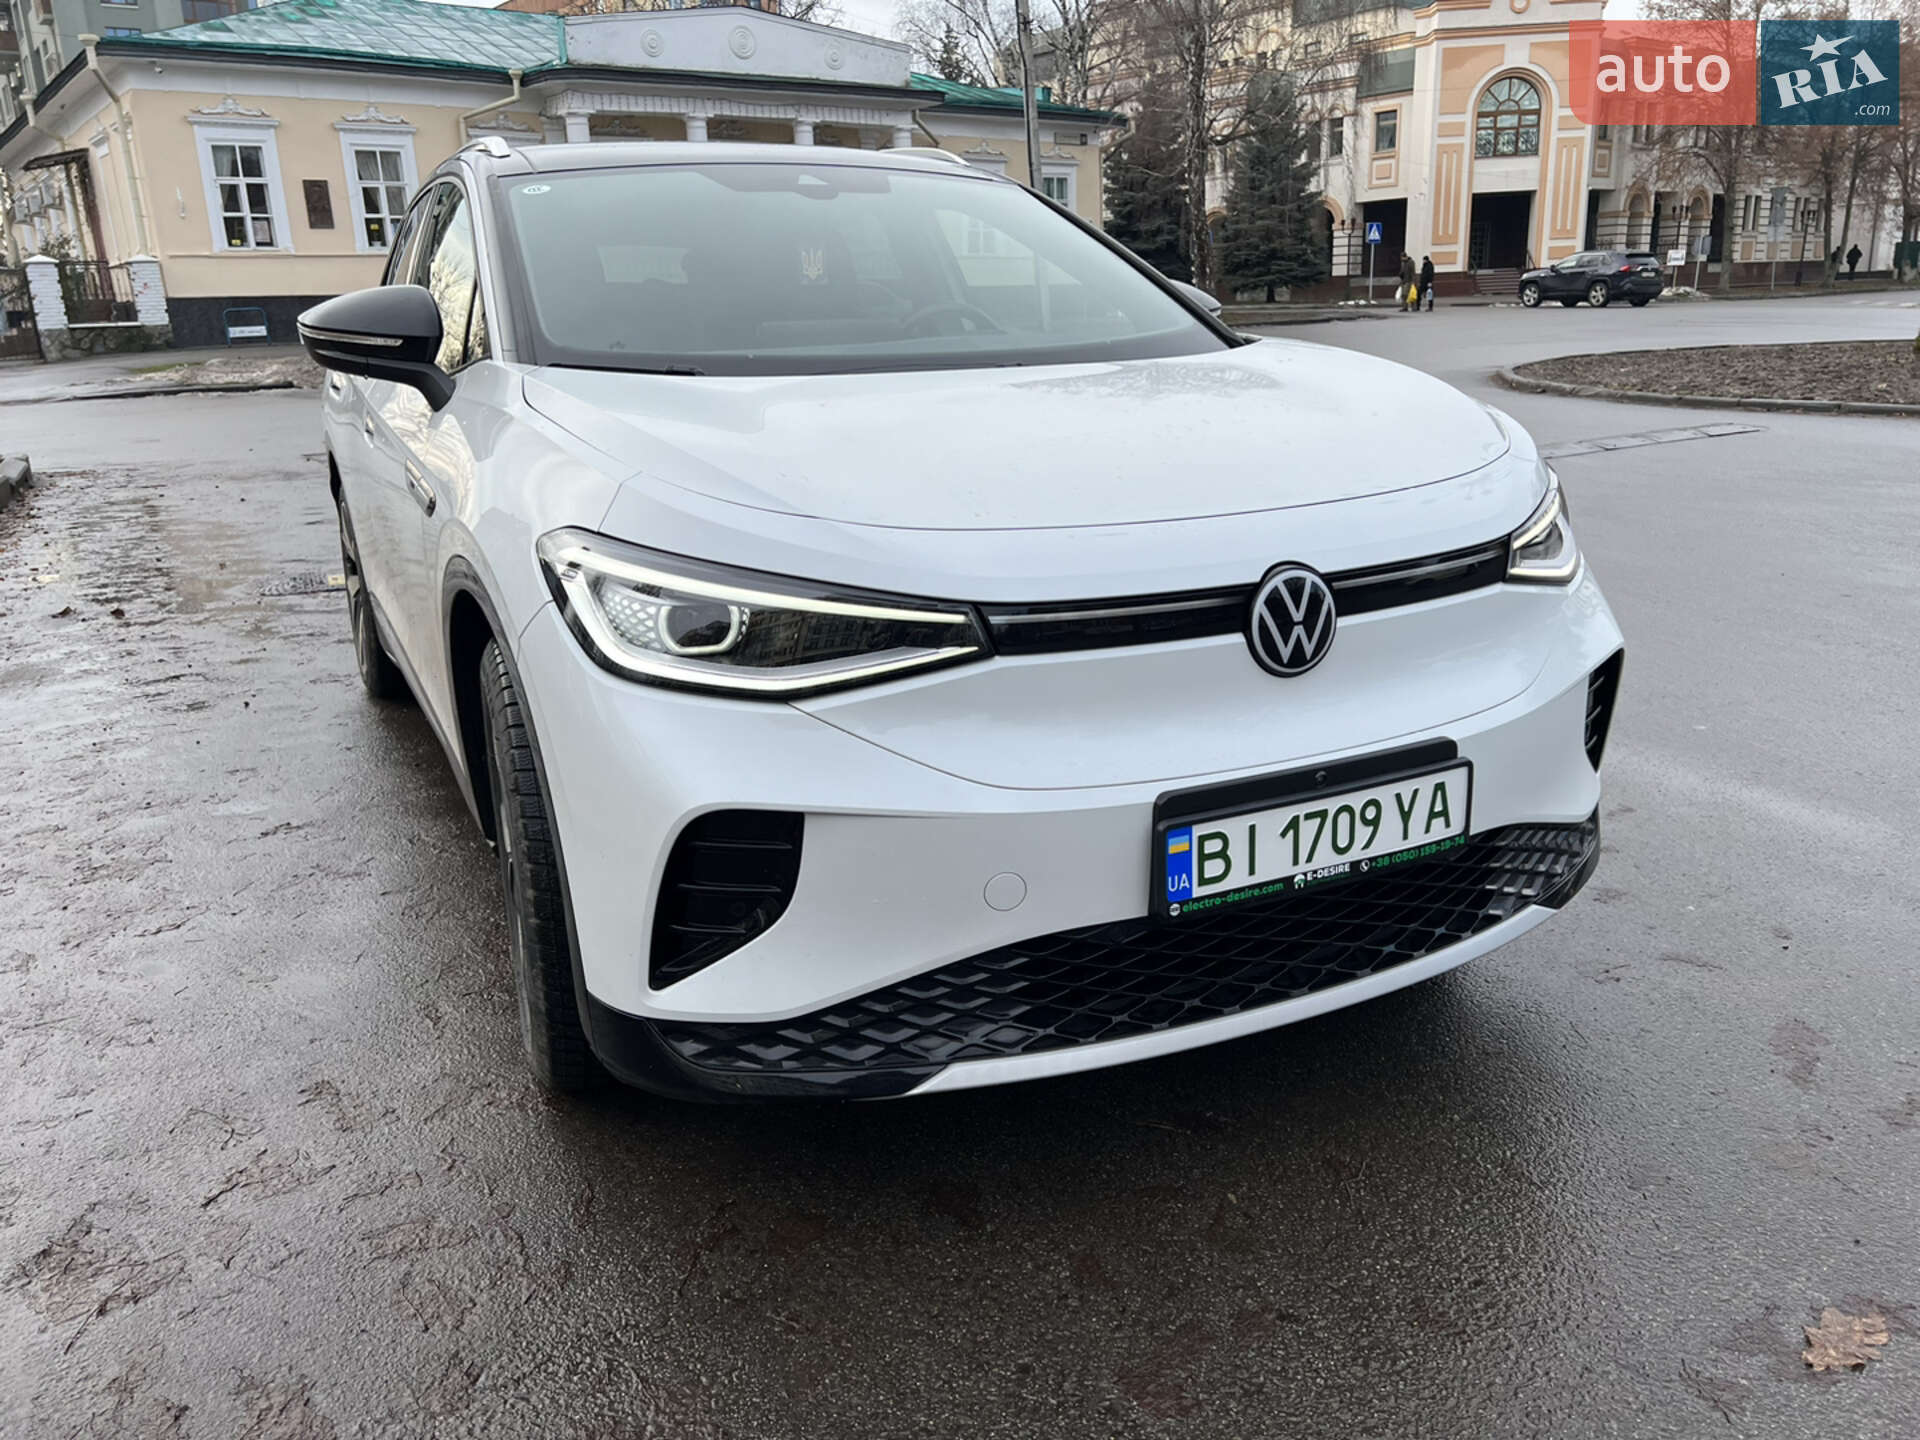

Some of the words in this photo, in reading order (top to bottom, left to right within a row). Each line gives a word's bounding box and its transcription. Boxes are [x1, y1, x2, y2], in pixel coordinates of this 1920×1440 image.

[1197, 823, 1257, 888] BI
[1279, 798, 1382, 867] 1709
[1394, 781, 1451, 841] YA
[1168, 873, 1190, 892] UA
[1306, 863, 1351, 881] E-DESIRE
[1182, 882, 1284, 913] electro-desire.com
